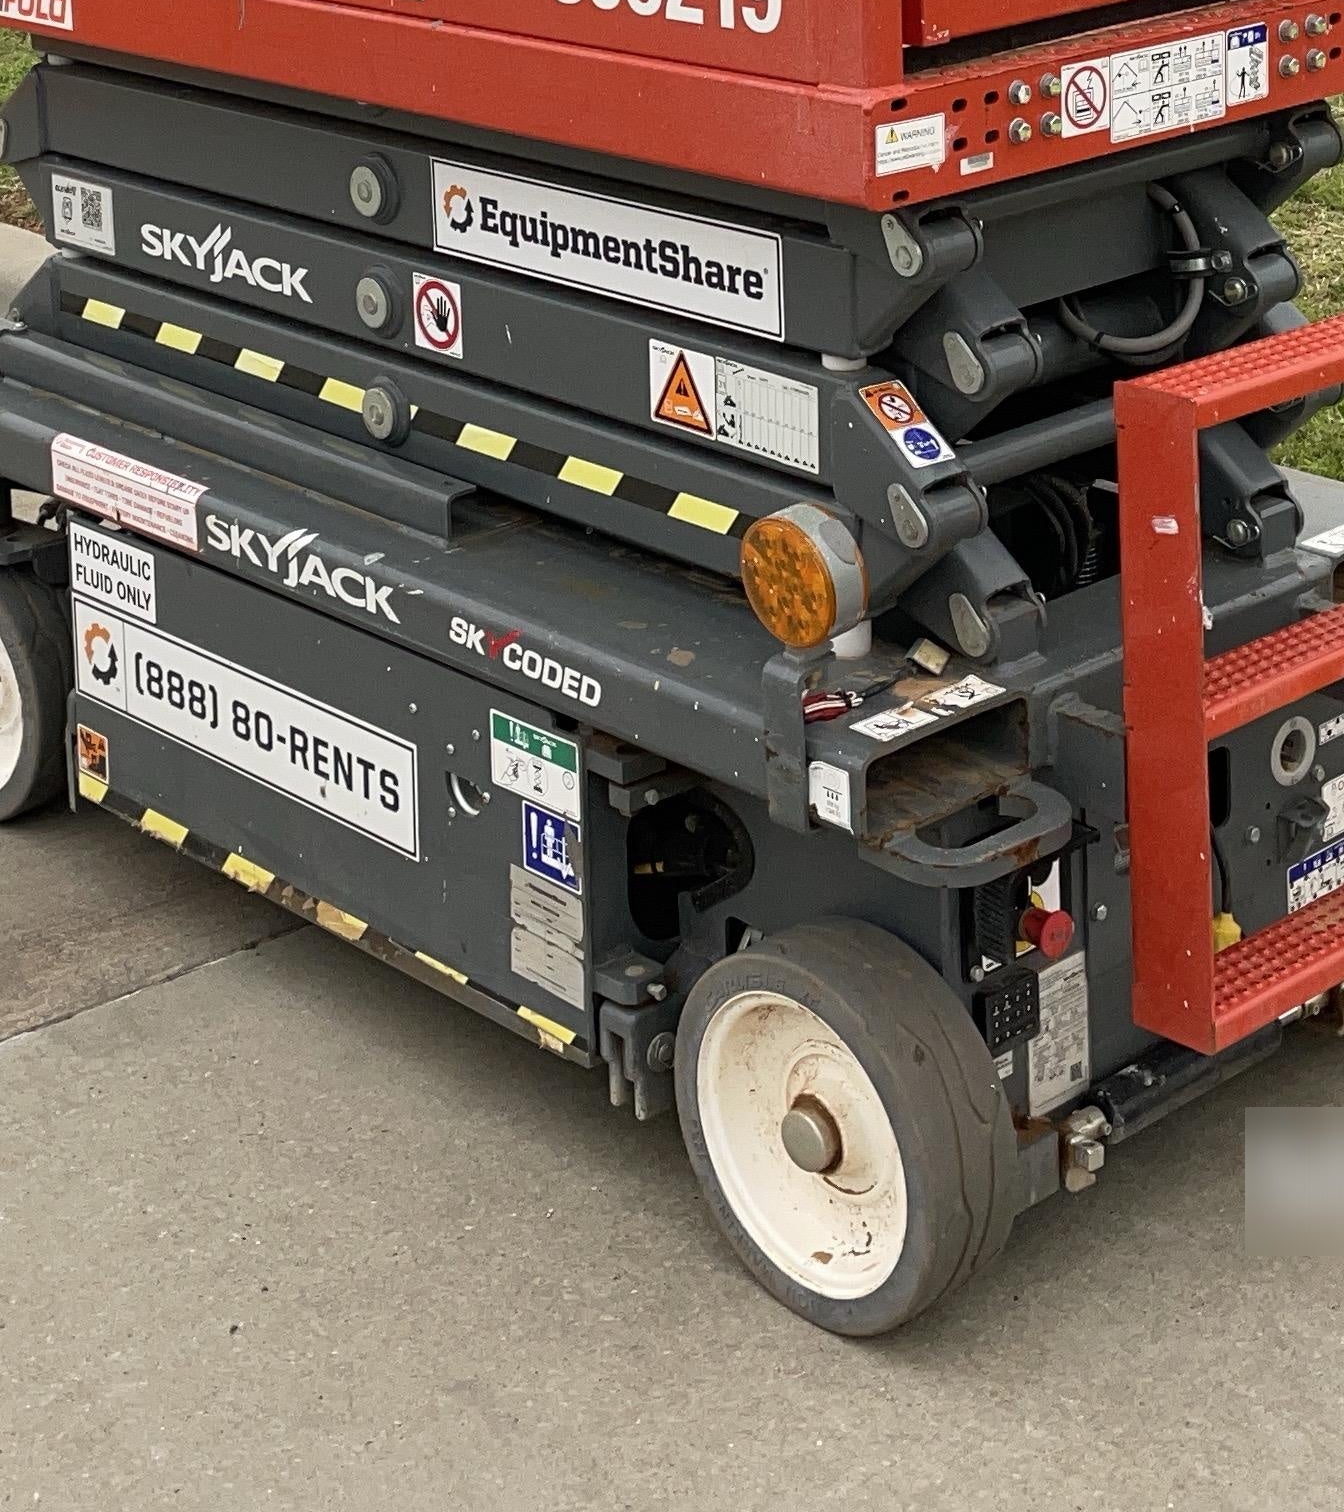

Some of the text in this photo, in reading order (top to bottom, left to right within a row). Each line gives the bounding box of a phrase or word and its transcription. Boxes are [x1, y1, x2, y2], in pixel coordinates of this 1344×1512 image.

[140, 223, 313, 304] SKYJACK
[74, 533, 150, 581] HYDRAULIC
[76, 563, 151, 611] FLUID ONLY
[204, 514, 401, 624] SKYJACK
[449, 616, 601, 707] SKYCODED
[134, 652, 400, 814] (888) 80-RENTS
